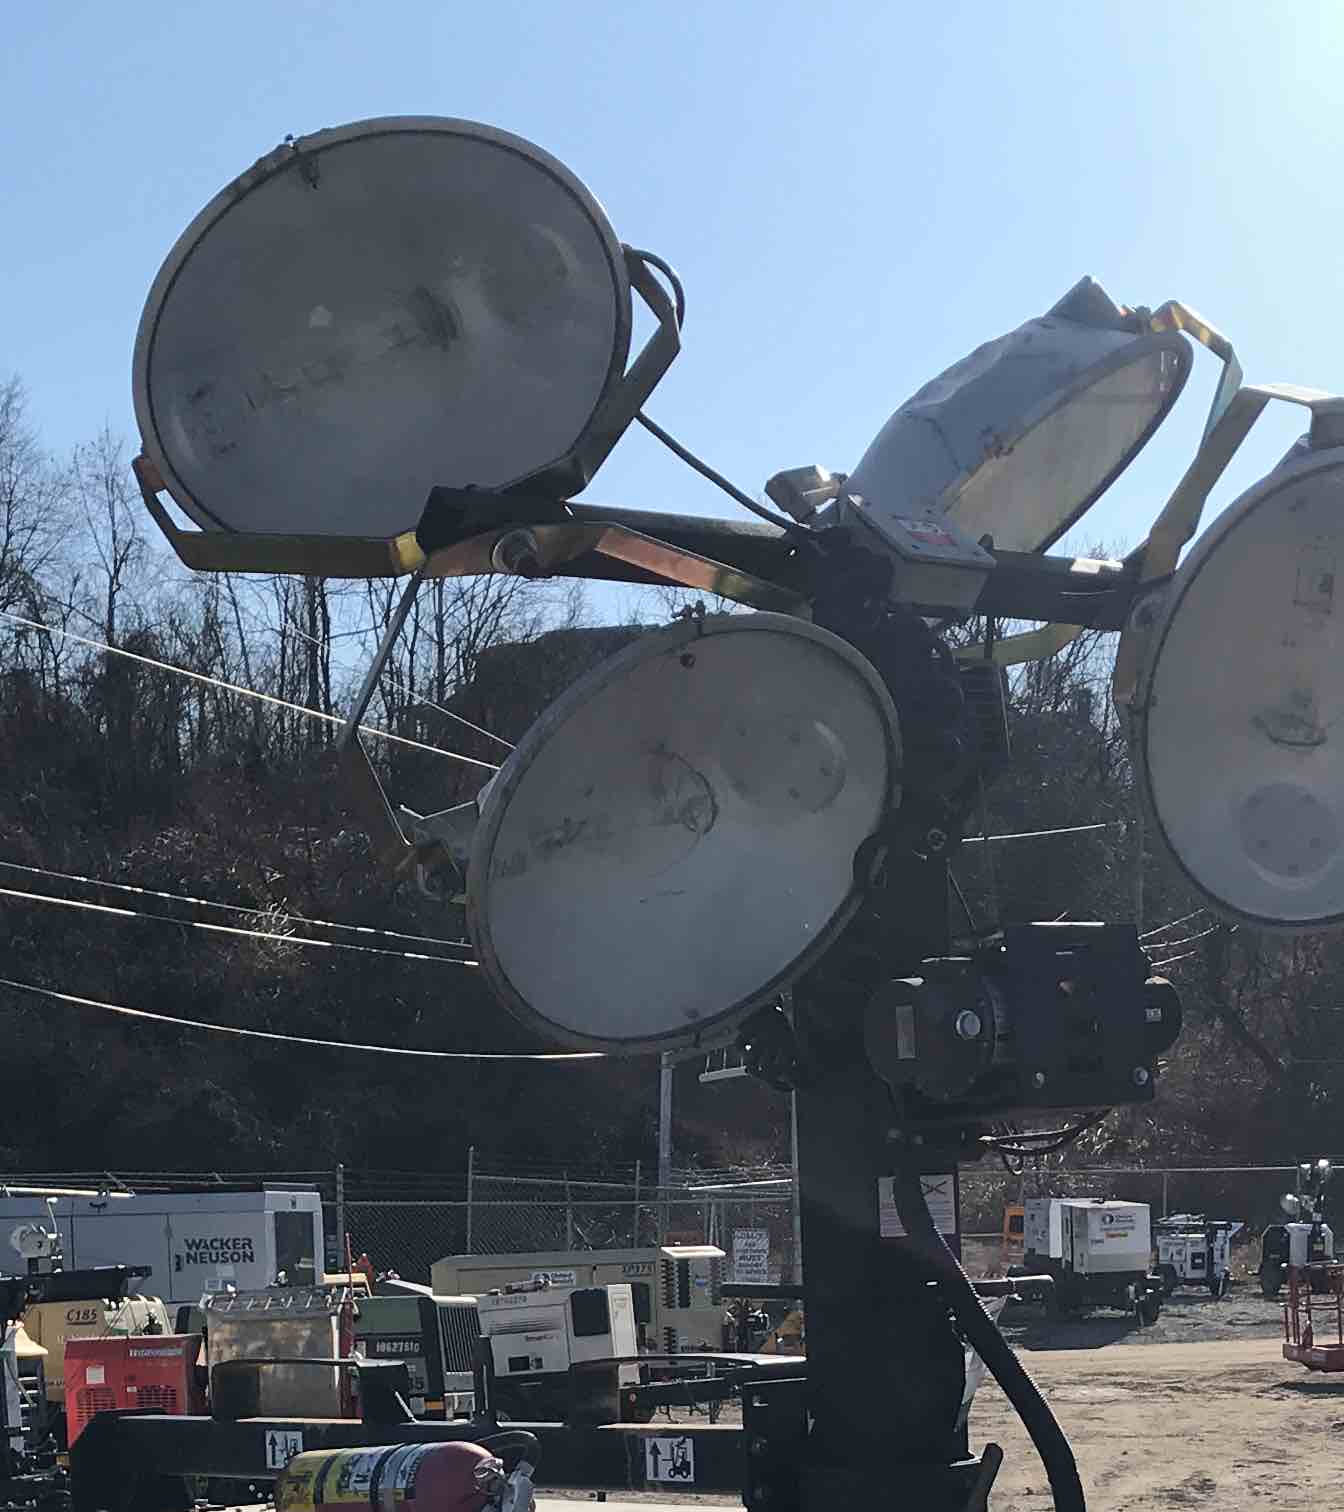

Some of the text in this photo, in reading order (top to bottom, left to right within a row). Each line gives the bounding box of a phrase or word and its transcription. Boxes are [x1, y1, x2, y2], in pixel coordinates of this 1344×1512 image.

[183, 1238, 254, 1251] WACKER
[185, 1251, 256, 1264] NEUSON
[66, 1309, 97, 1322] C185
